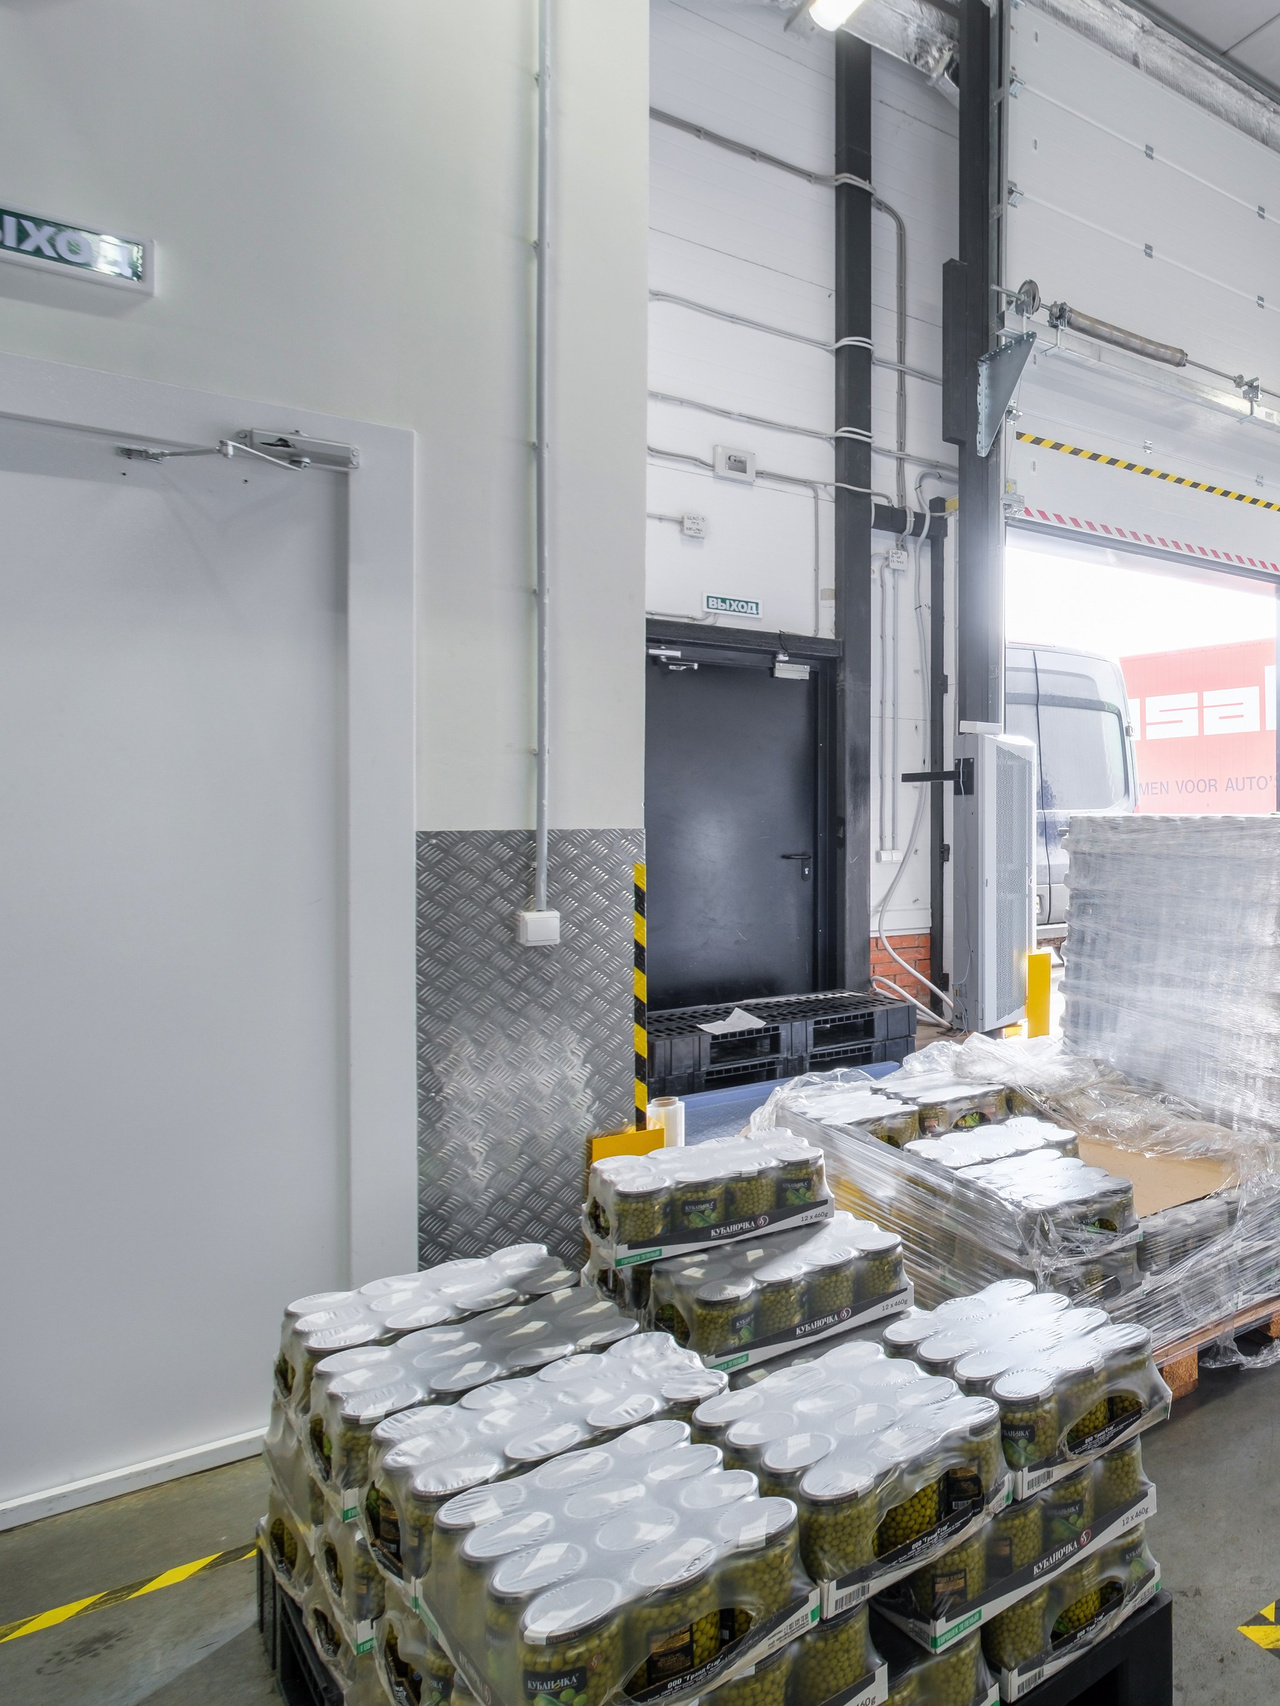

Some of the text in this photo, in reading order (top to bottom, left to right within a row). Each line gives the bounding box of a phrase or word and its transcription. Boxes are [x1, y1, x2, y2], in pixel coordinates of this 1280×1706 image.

[708, 597, 757, 614] ВЫХОД
[1175, 778, 1218, 794] VOOR
[1225, 775, 1276, 792] AUTO'
[711, 1220, 755, 1237] КУБАНОЧКА
[796, 1314, 839, 1335] КУБАНОЧКА
[1122, 1517, 1130, 1527] 12
[1135, 1506, 1149, 1519] 460g
[1033, 1540, 1078, 1576] КУБАНОЧКА
[667, 1677, 682, 1689] ООО
